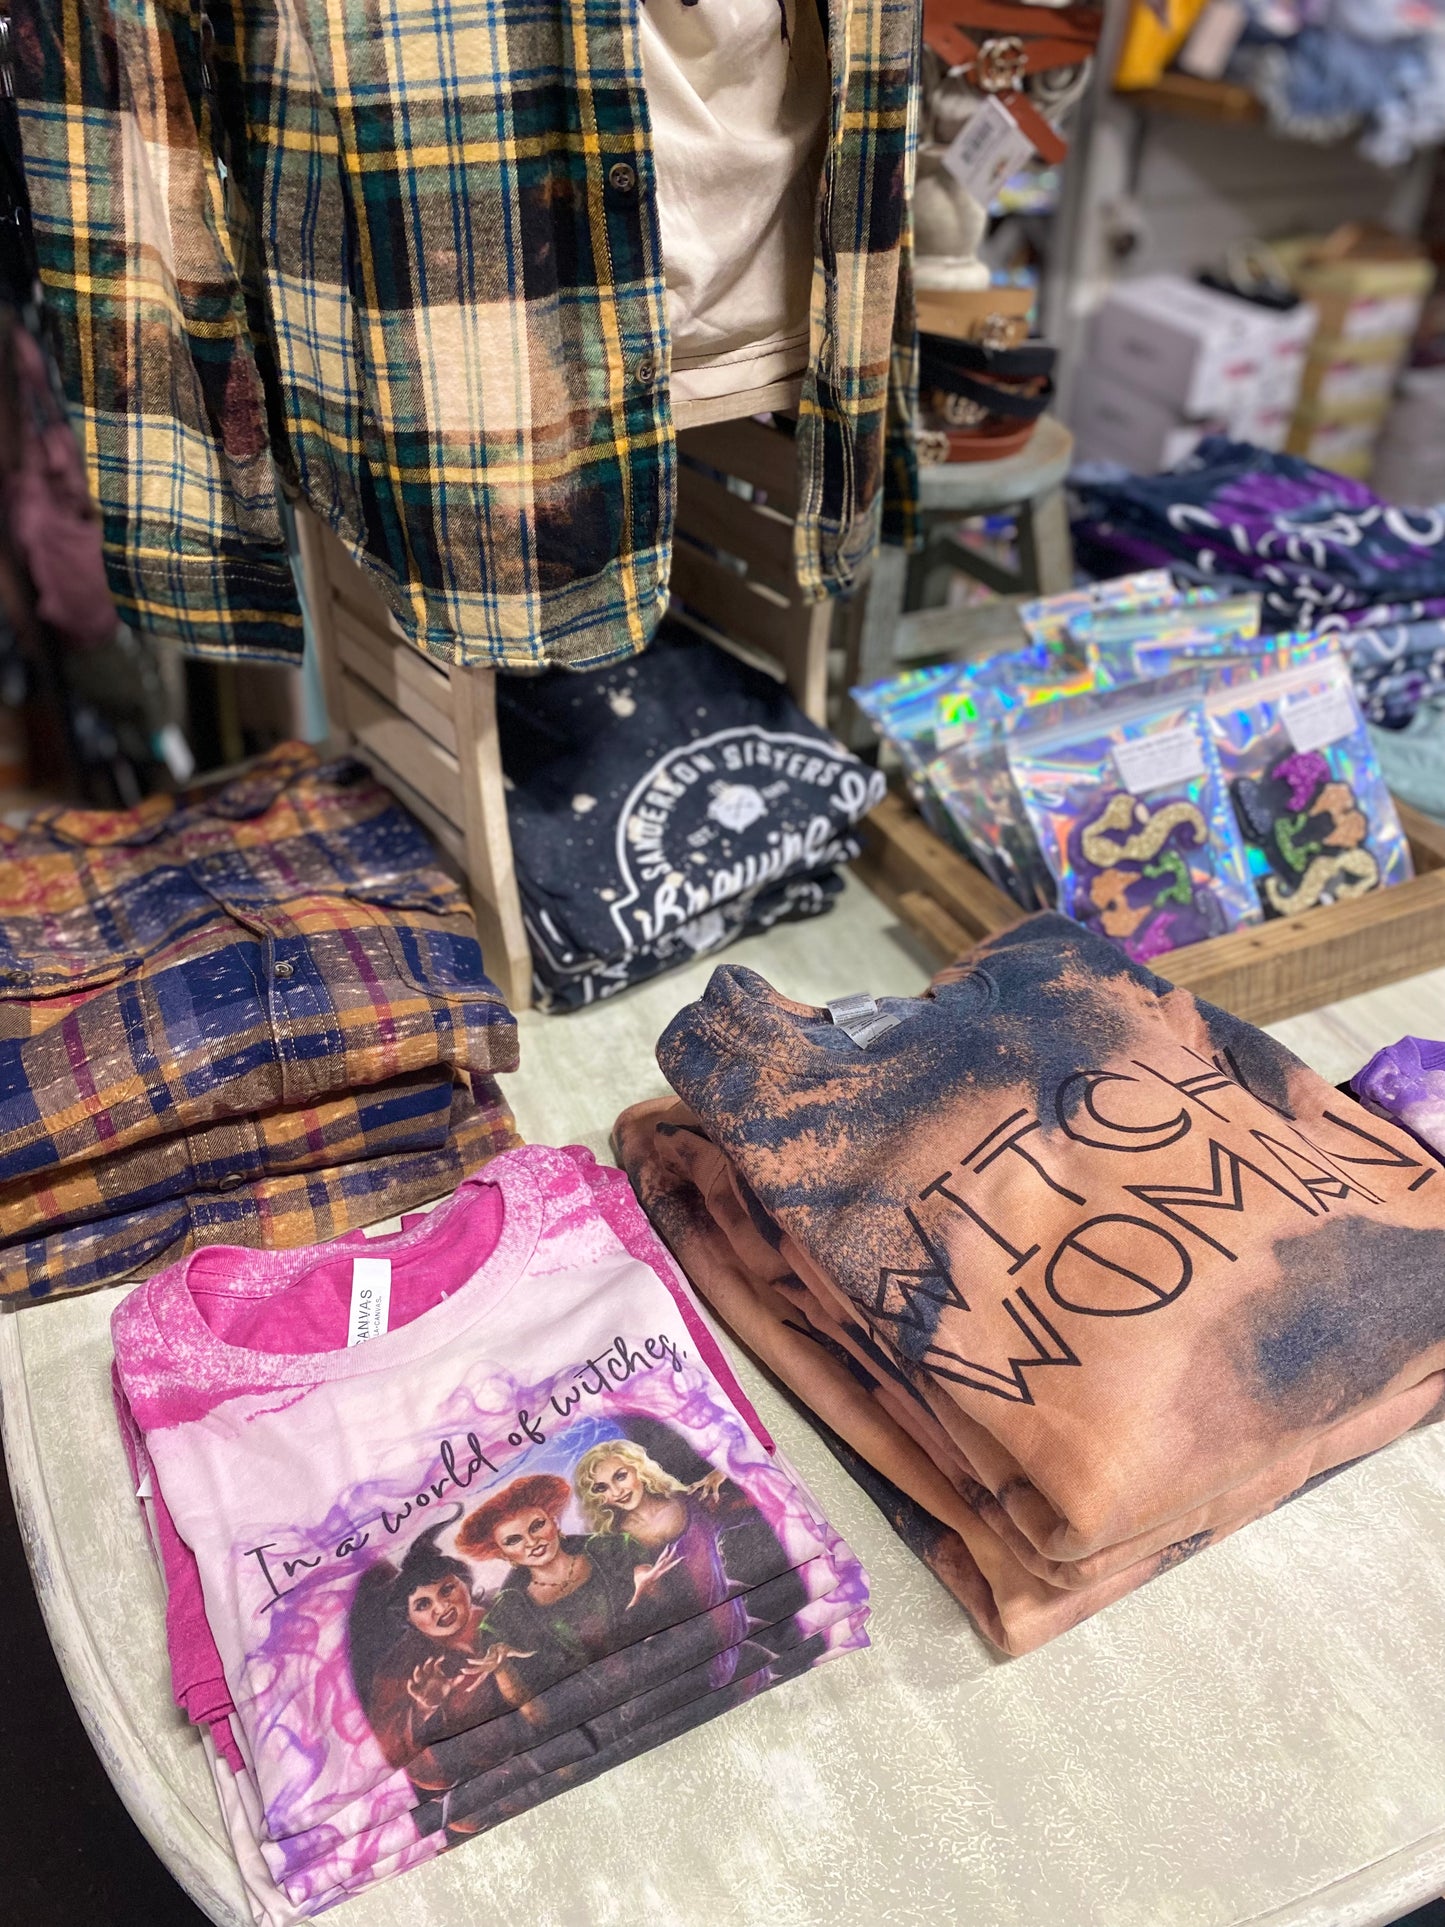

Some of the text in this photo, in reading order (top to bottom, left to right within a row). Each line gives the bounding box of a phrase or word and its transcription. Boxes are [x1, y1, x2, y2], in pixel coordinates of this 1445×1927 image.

[633, 741, 843, 882] SANDERSON SISTERS
[850, 1046, 1296, 1330] WITCH
[919, 1111, 1437, 1406] WOMAN
[244, 1543, 322, 1614] In
[335, 1531, 370, 1559] a
[380, 1433, 500, 1533] world
[507, 1410, 547, 1448] of
